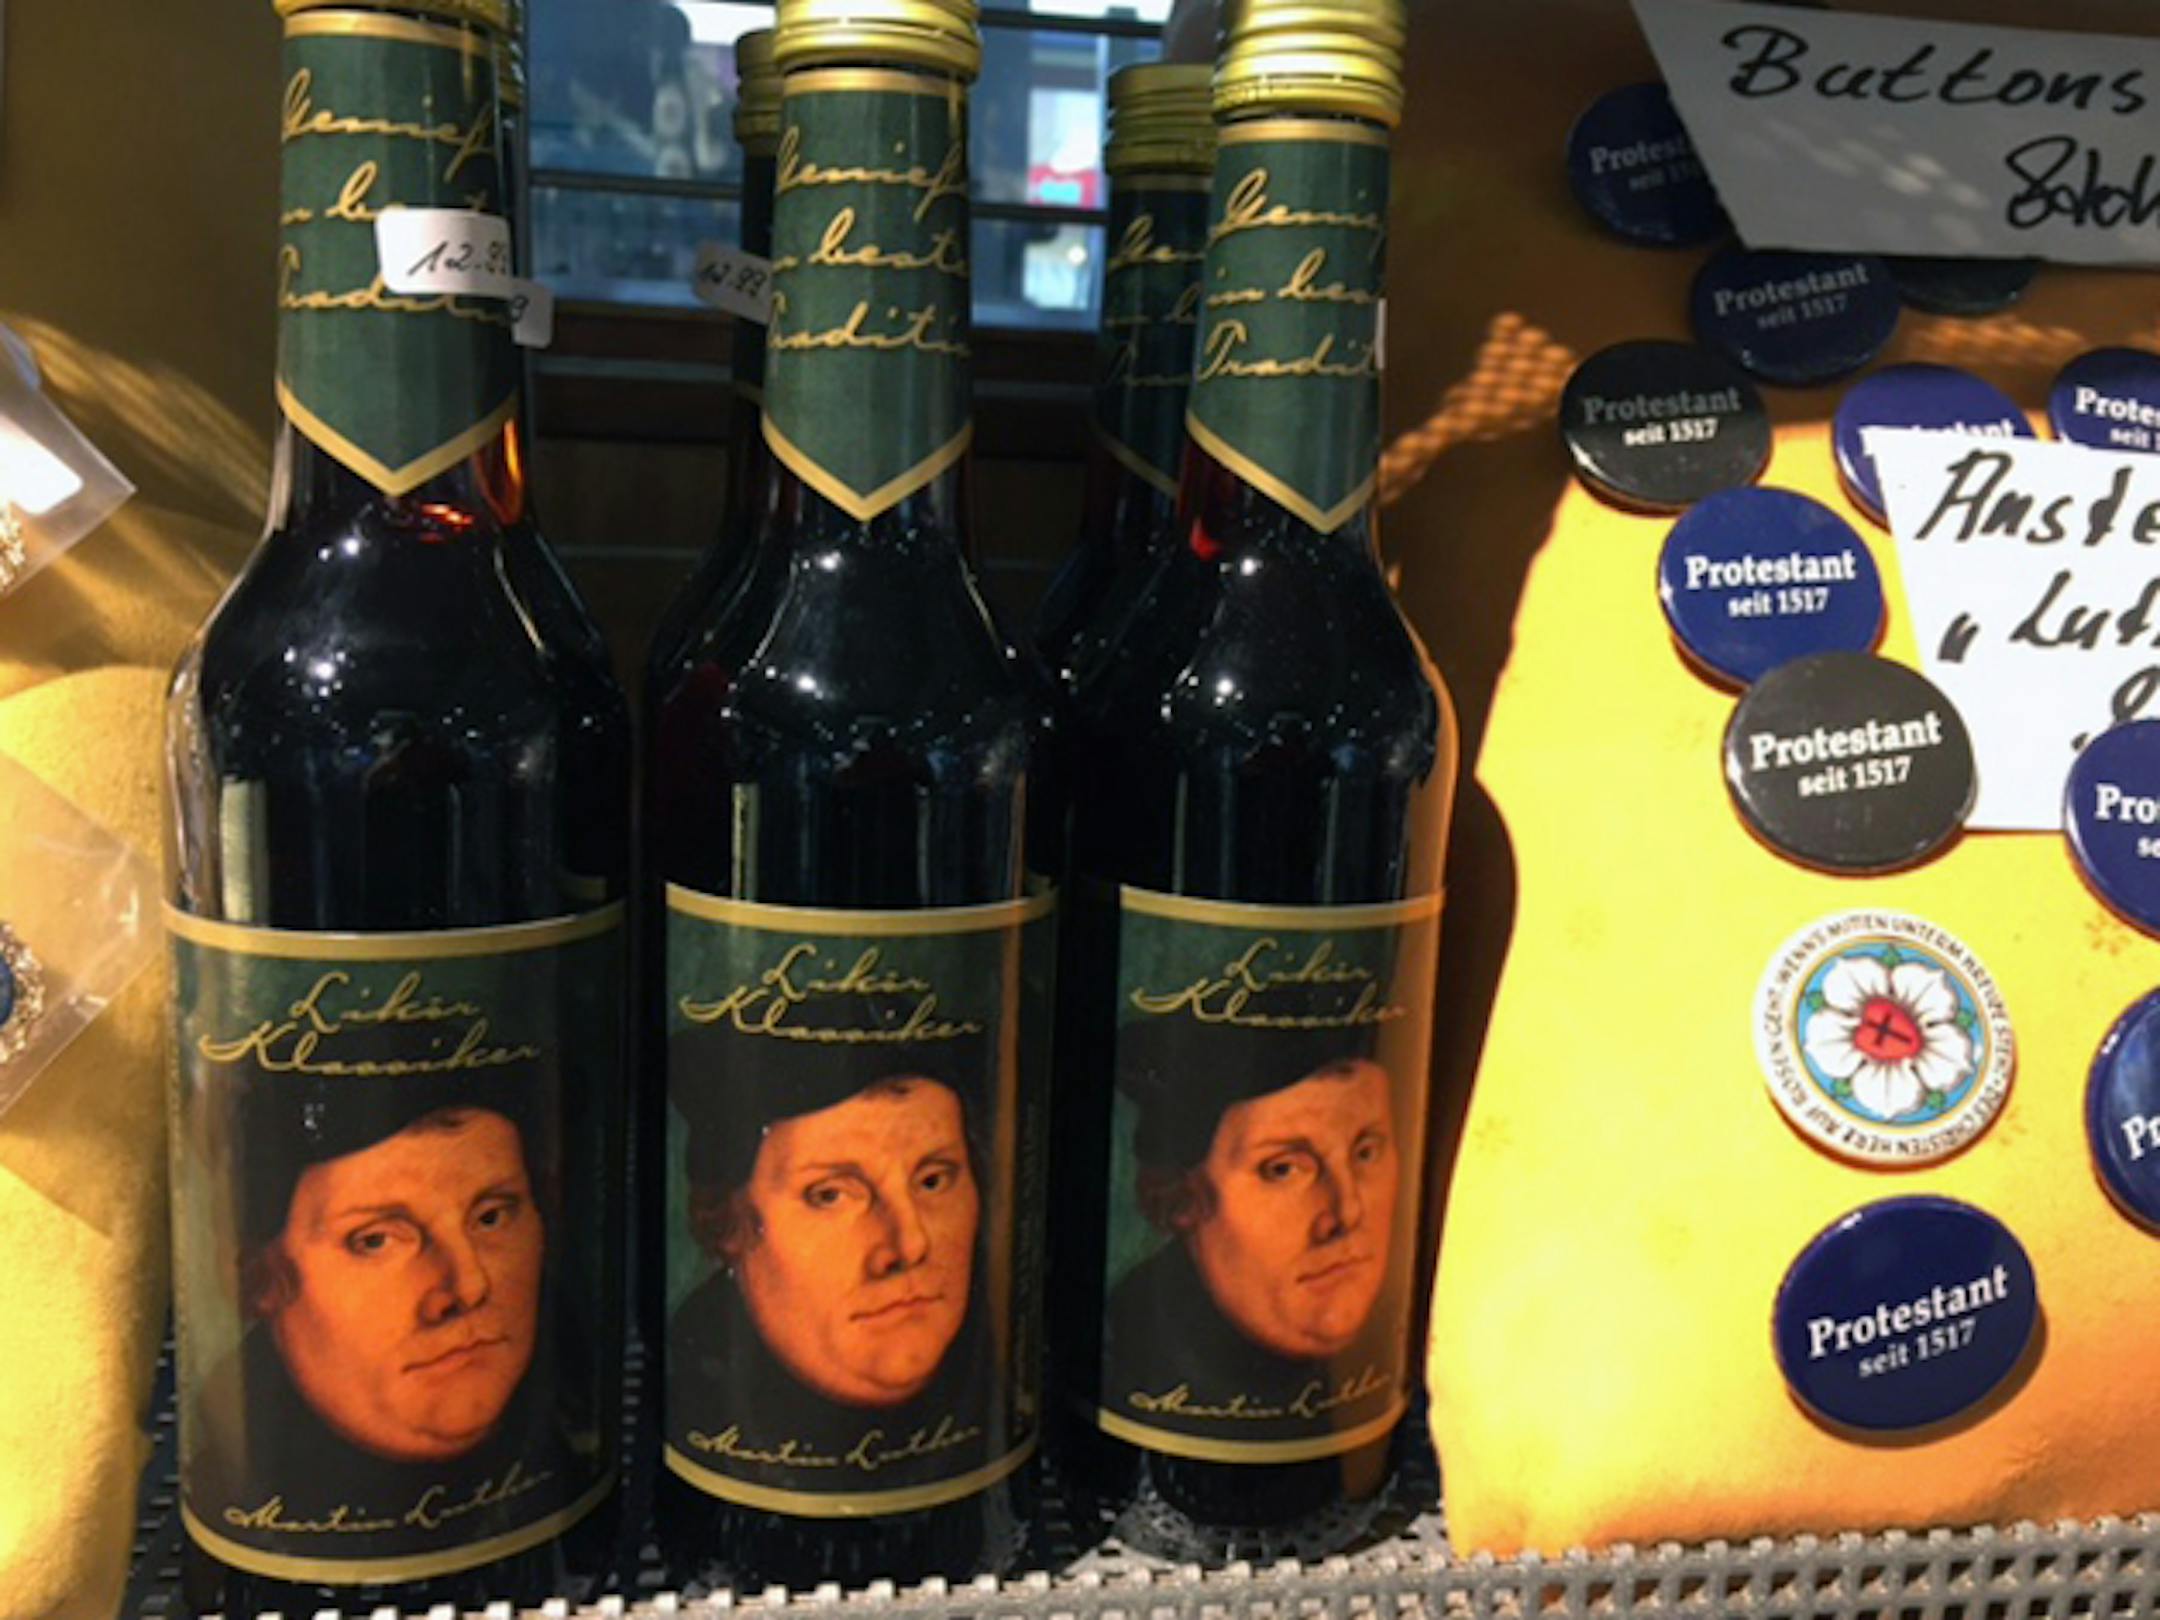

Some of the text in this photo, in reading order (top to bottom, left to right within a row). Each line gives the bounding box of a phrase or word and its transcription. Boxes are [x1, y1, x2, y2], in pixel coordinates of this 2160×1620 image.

[1721, 23, 2147, 115] Buttons
[1714, 262, 1870, 316] Protestant
[1757, 294, 1849, 330] seit 1517
[1584, 386, 1741, 424] Protestant
[1624, 417, 1719, 446] seit 1517
[2110, 427, 2150, 450] seit
[1685, 549, 1857, 590] Protestant
[1728, 588, 1831, 617] seit 1517
[1750, 711, 1942, 771] Protestant
[1798, 756, 1912, 797] seit 1517
[2095, 783, 2160, 824] Pro
[679, 985, 984, 1043] Klassiker
[1130, 977, 1408, 1028] Klassiker
[198, 1018, 541, 1077] Klassiker
[1807, 1262, 2010, 1360] Protestant
[1858, 1318, 1977, 1379] seit 1517
[1128, 1364, 1393, 1419] Martin Luther
[686, 1414, 981, 1471] Martin Luther
[223, 1459, 554, 1533] Martin Luther
